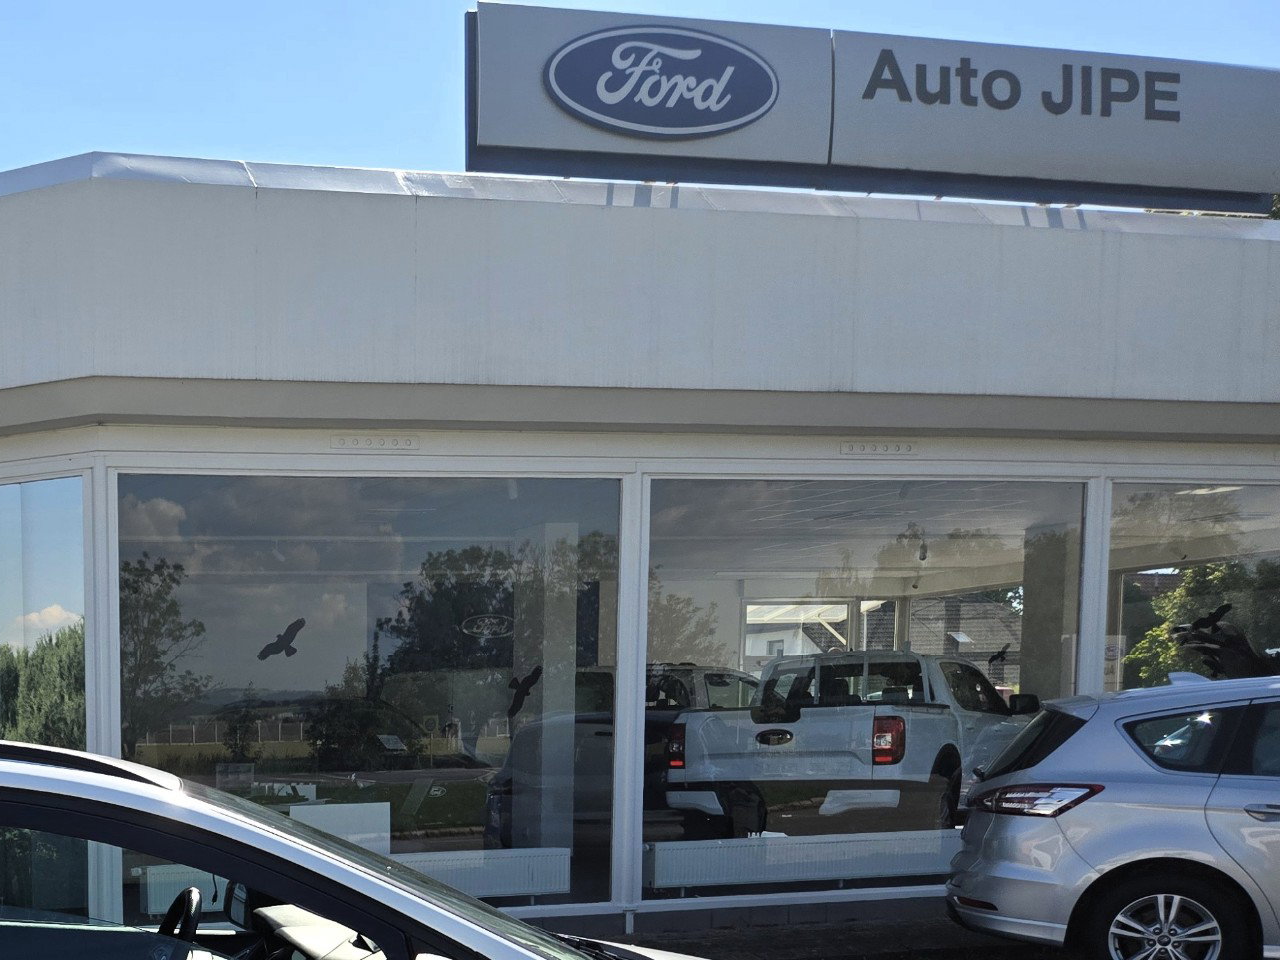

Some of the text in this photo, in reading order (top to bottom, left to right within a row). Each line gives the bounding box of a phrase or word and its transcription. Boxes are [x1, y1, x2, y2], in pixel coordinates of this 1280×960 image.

[596, 40, 736, 112] Ford
[861, 48, 1182, 123] Auto JIPE
